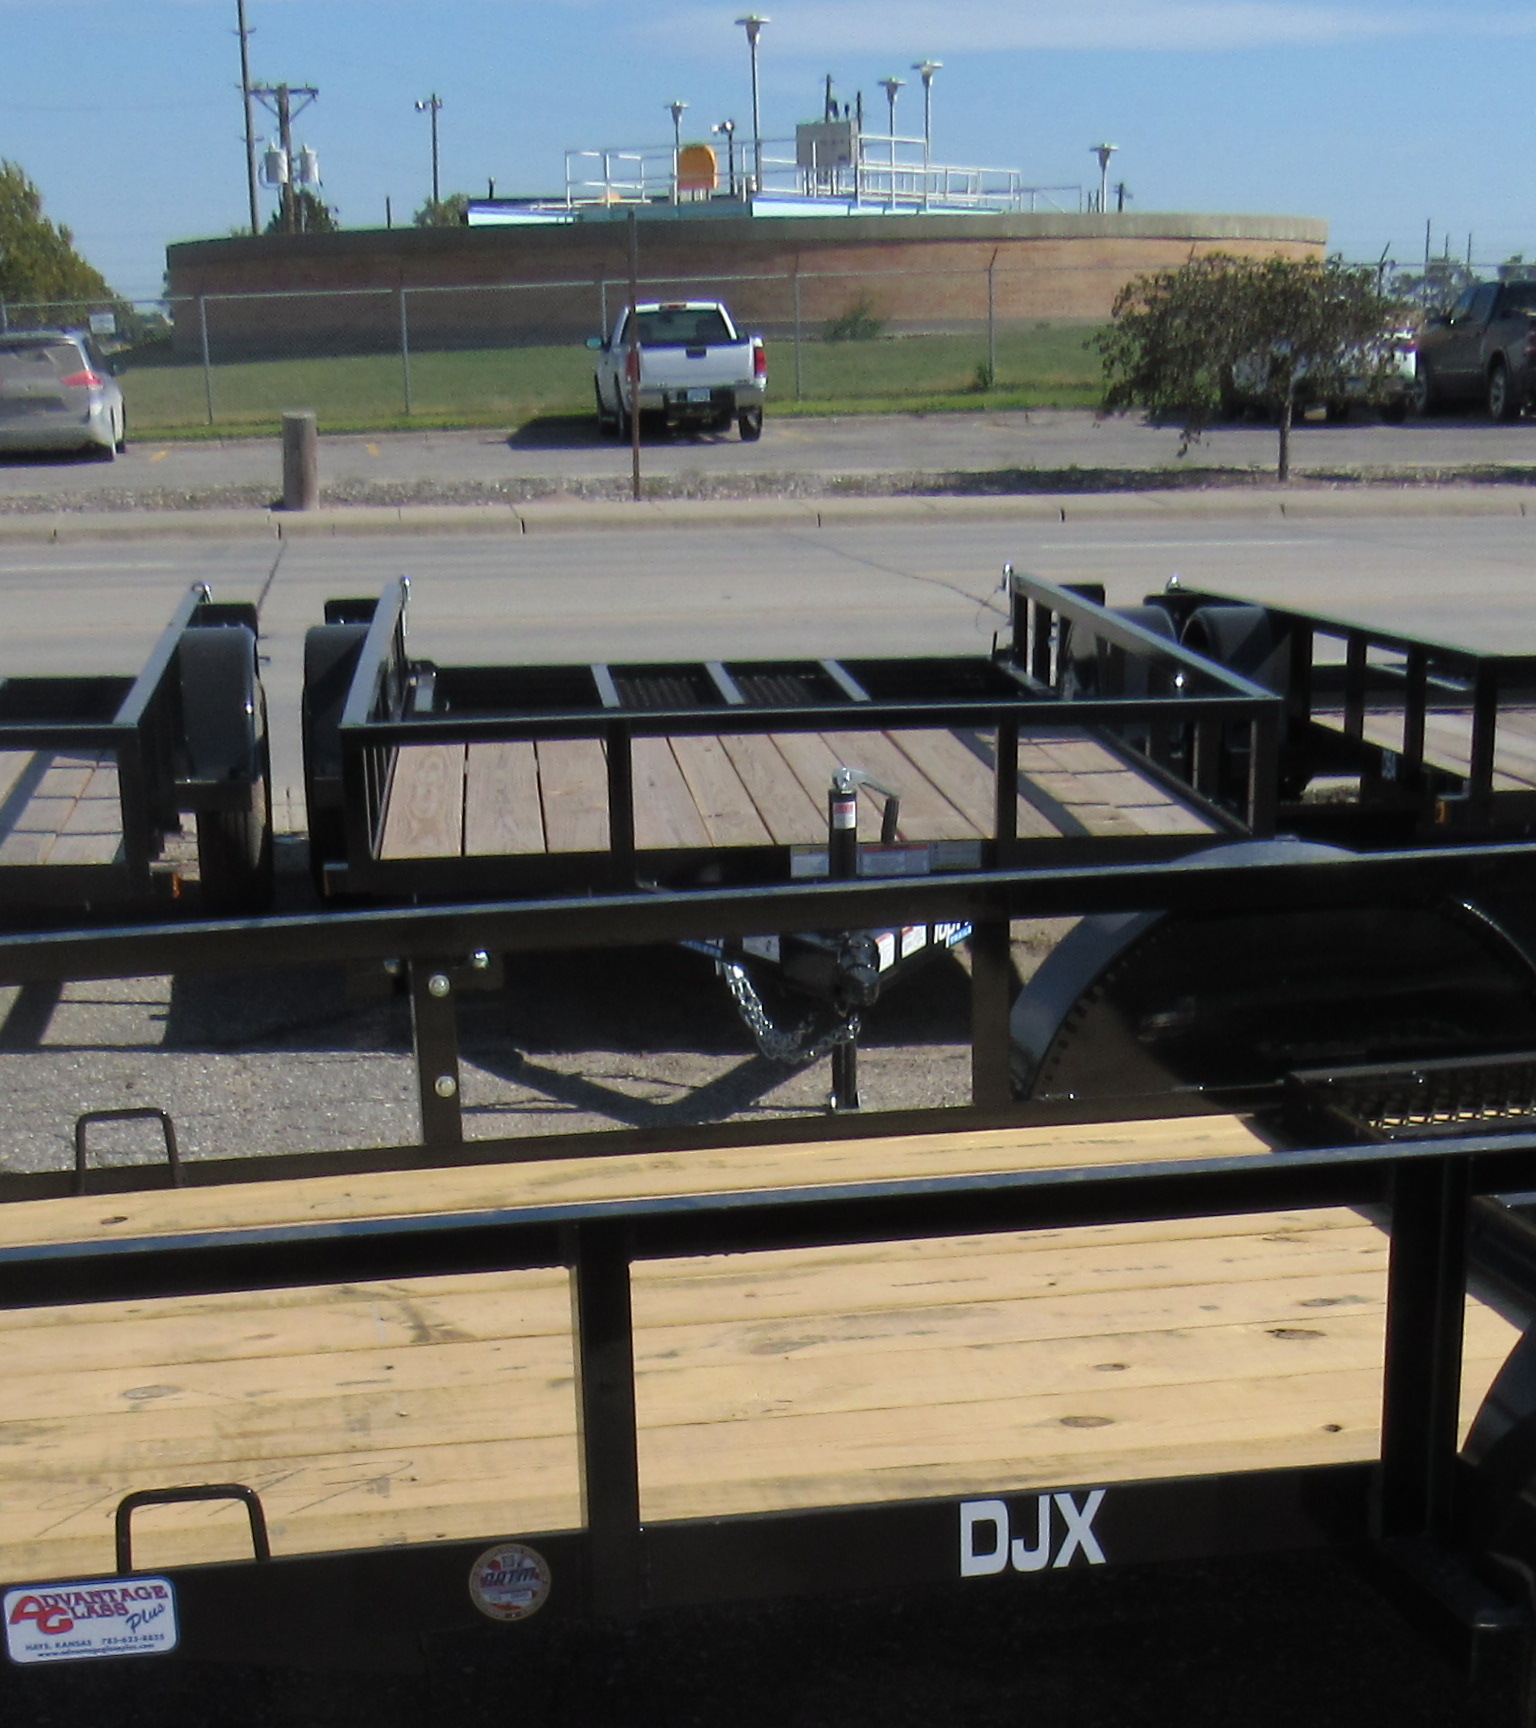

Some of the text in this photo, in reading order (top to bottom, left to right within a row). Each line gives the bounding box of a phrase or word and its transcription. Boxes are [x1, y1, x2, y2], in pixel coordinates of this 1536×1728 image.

[960, 1488, 1107, 1578] DJX
[9, 1585, 169, 1624] ADVANTAGE
[125, 1603, 167, 1633] Plus
[55, 1640, 92, 1649] KANSAS
